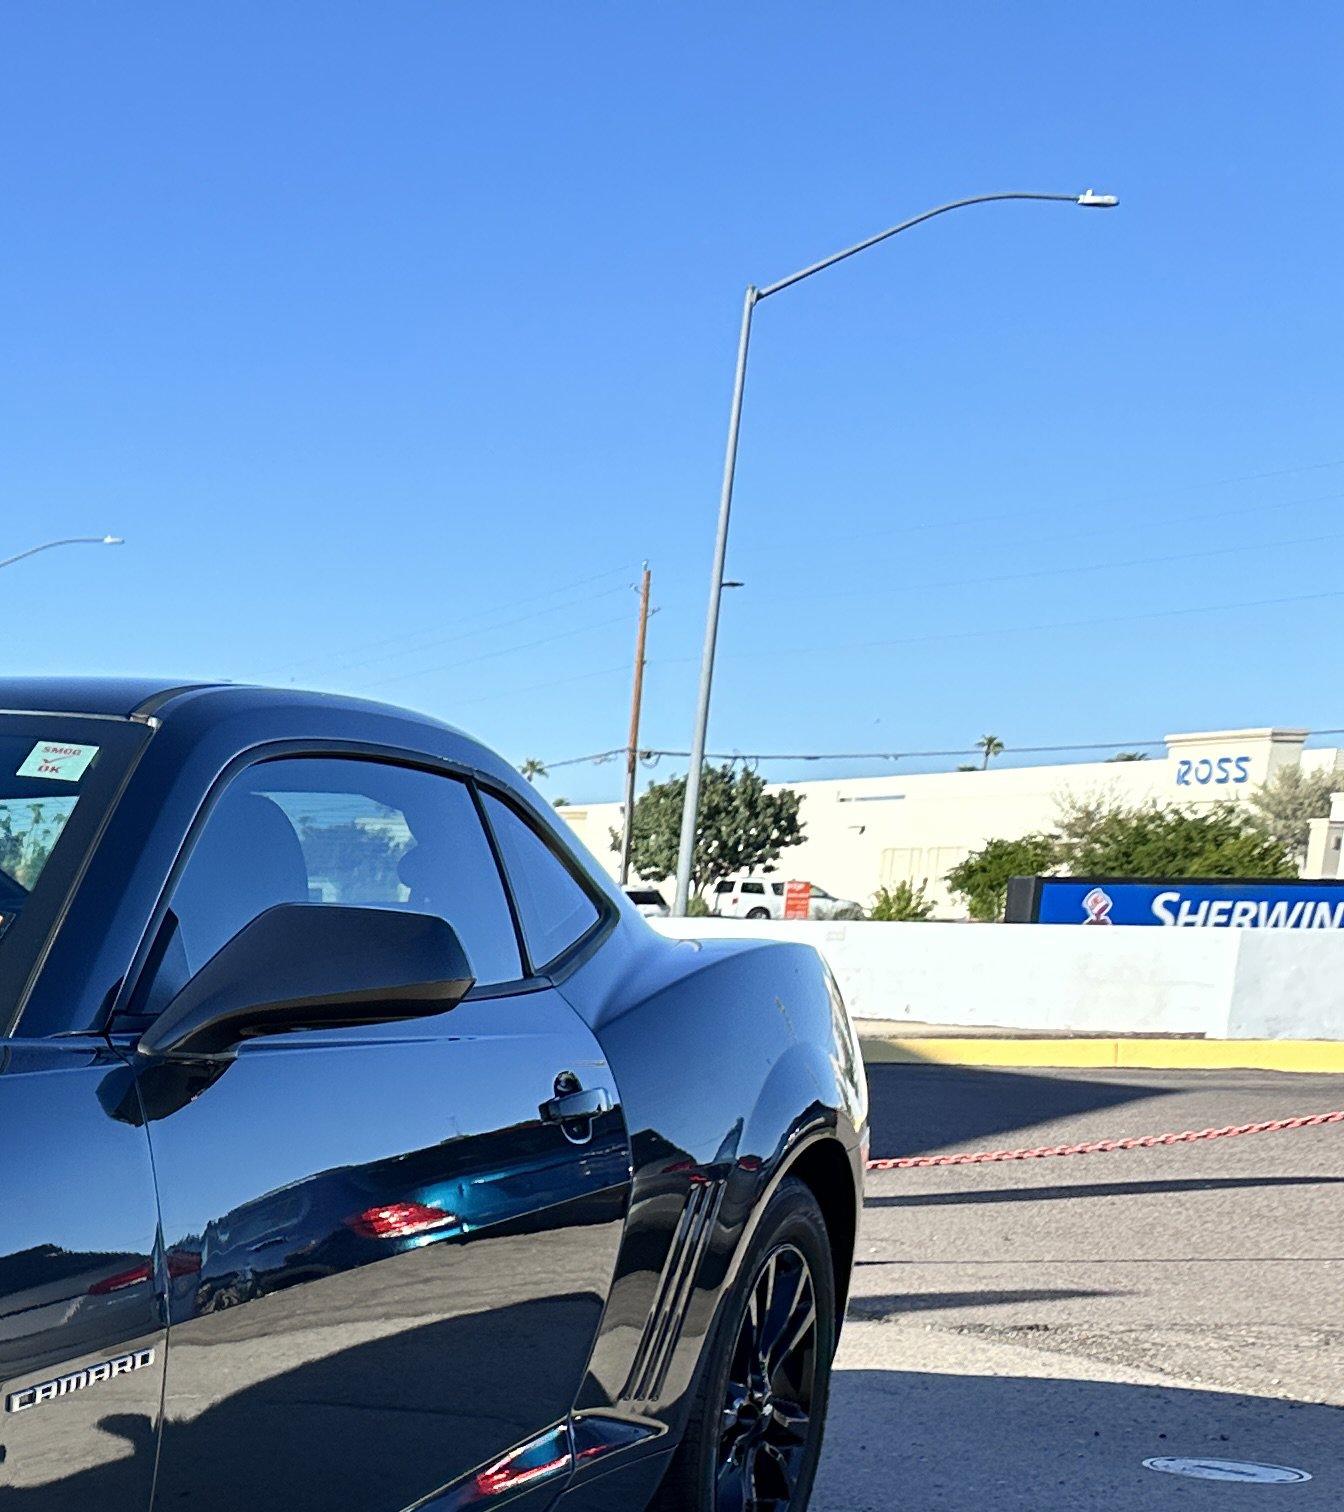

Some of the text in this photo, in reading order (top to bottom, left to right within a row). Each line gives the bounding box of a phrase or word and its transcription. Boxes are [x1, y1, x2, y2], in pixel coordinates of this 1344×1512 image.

[37, 765, 64, 774] OK
[1176, 756, 1251, 786] ROSS
[1151, 891, 1344, 929] SHERWIN
[5, 1348, 156, 1413] CAMARO
